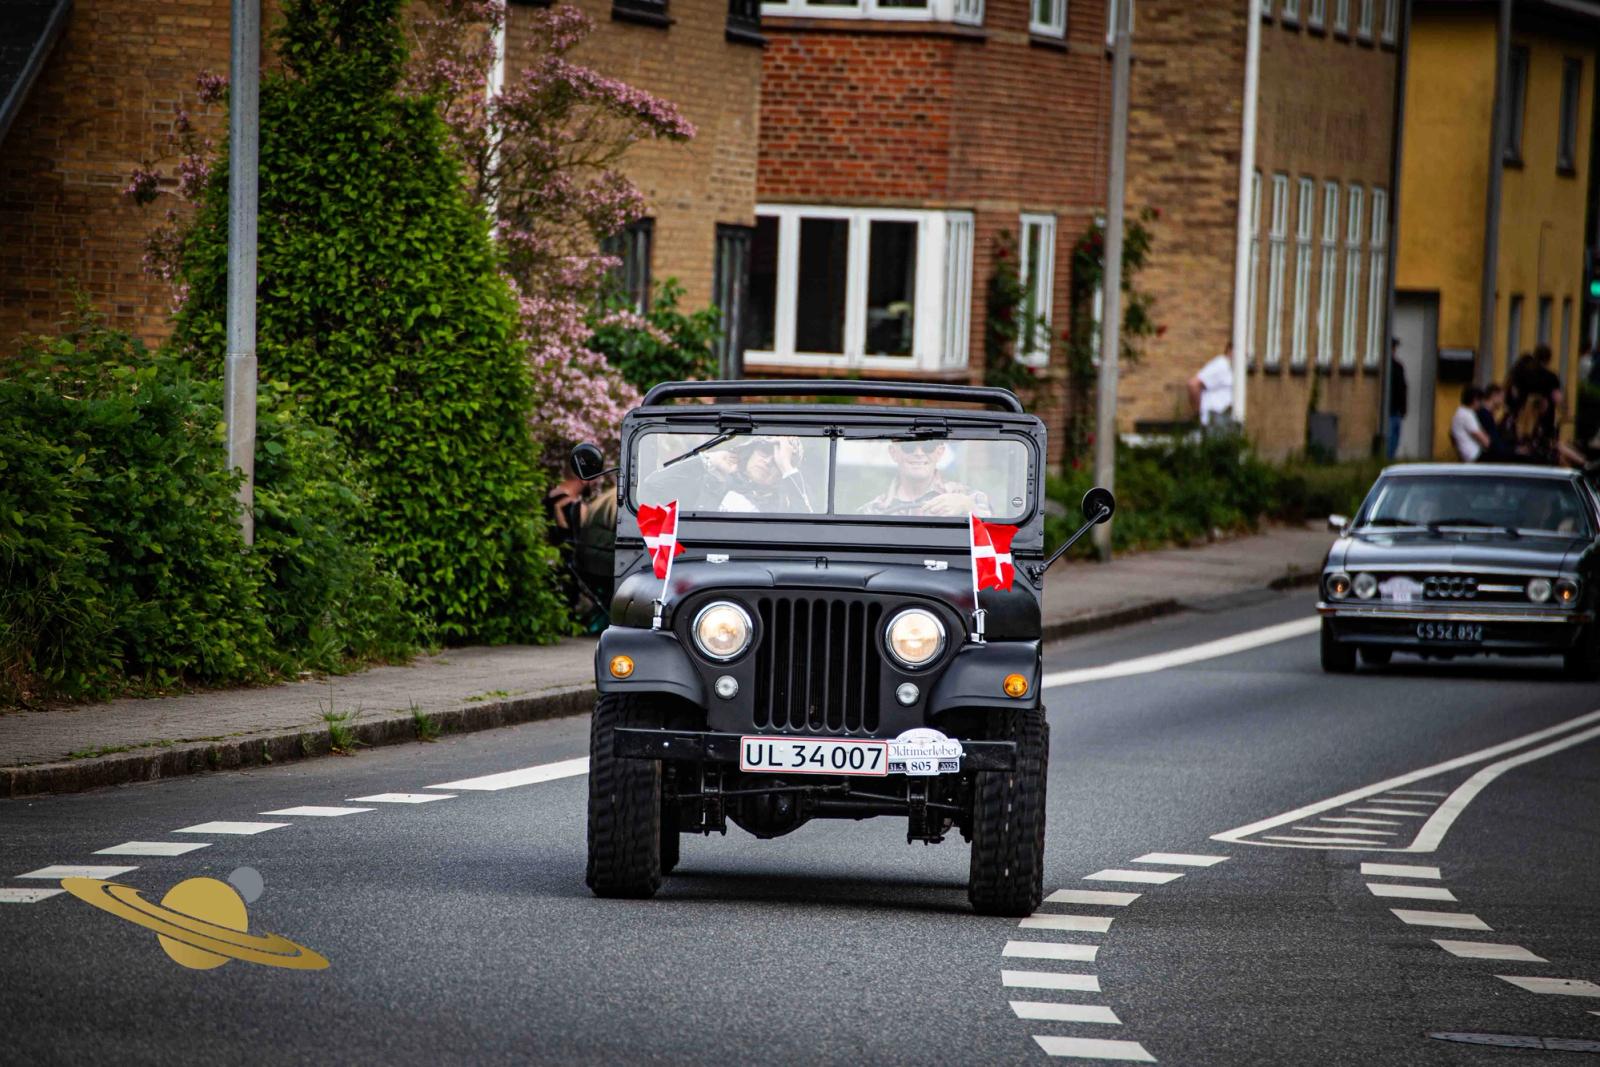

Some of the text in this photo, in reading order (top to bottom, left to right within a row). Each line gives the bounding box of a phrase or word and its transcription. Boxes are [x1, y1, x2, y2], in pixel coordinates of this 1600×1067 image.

[746, 743, 783, 767] UL
[911, 761, 932, 771] 805
[940, 762, 957, 771] 2025
